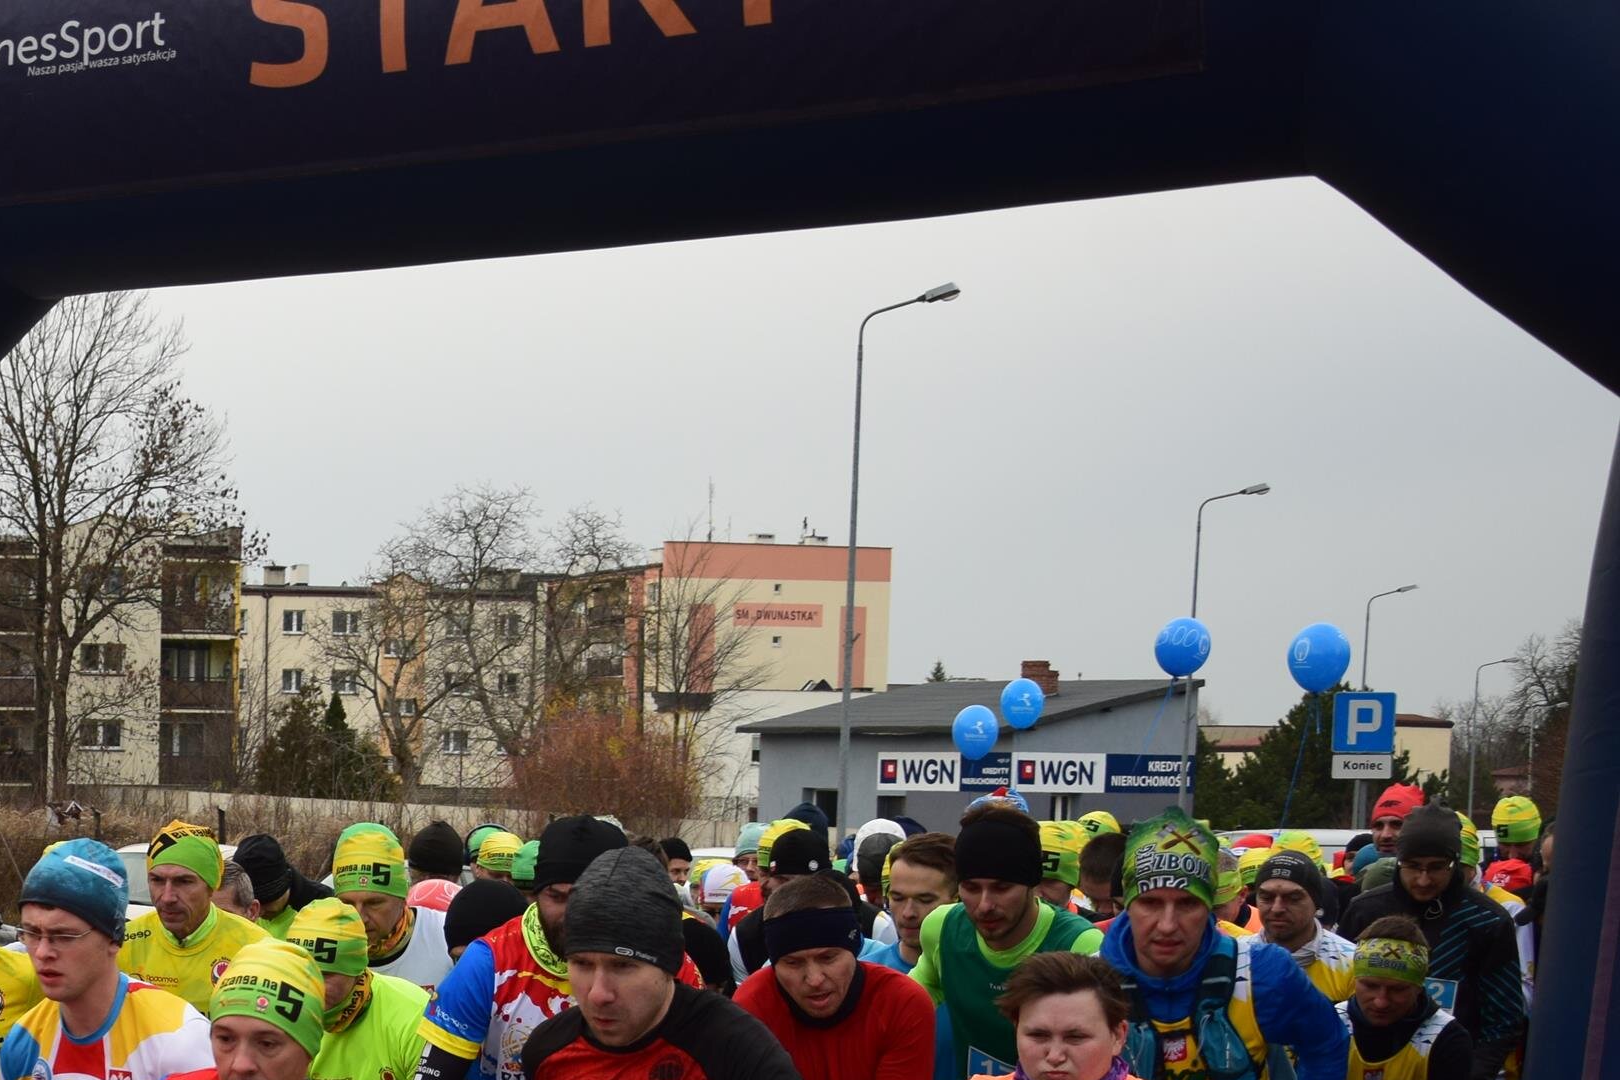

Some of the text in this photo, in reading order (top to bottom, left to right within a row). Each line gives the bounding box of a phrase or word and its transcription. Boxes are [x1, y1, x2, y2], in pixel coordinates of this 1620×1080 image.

[27, 65, 56, 77] Nasza
[89, 56, 119, 69] wasza
[121, 48, 177, 65] satysfakcja
[1347, 699, 1382, 745] P
[902, 759, 955, 784] WGN
[1041, 760, 1095, 786] WGN
[1343, 760, 1383, 770] Koniec
[1111, 774, 1191, 787] NIERUCHOMOŚI
[372, 863, 390, 886] 5
[314, 937, 338, 964] 5
[262, 979, 278, 991] na
[275, 981, 305, 1023] 5
